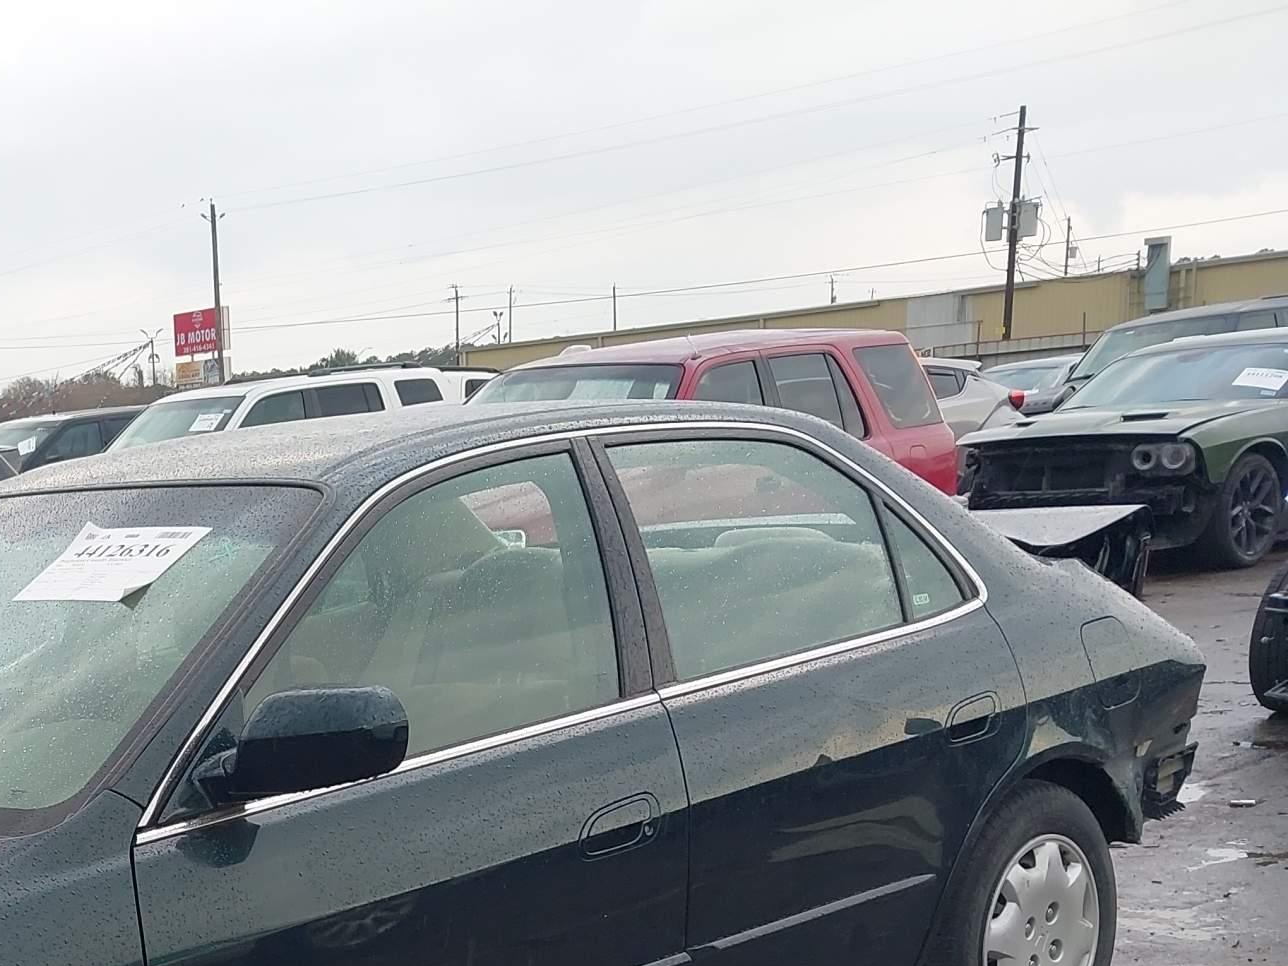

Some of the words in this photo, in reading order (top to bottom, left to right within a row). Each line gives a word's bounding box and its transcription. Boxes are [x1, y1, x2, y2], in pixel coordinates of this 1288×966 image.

[177, 333, 186, 346] JB
[188, 328, 216, 344] MOTOR
[74, 543, 176, 558] 44126316
